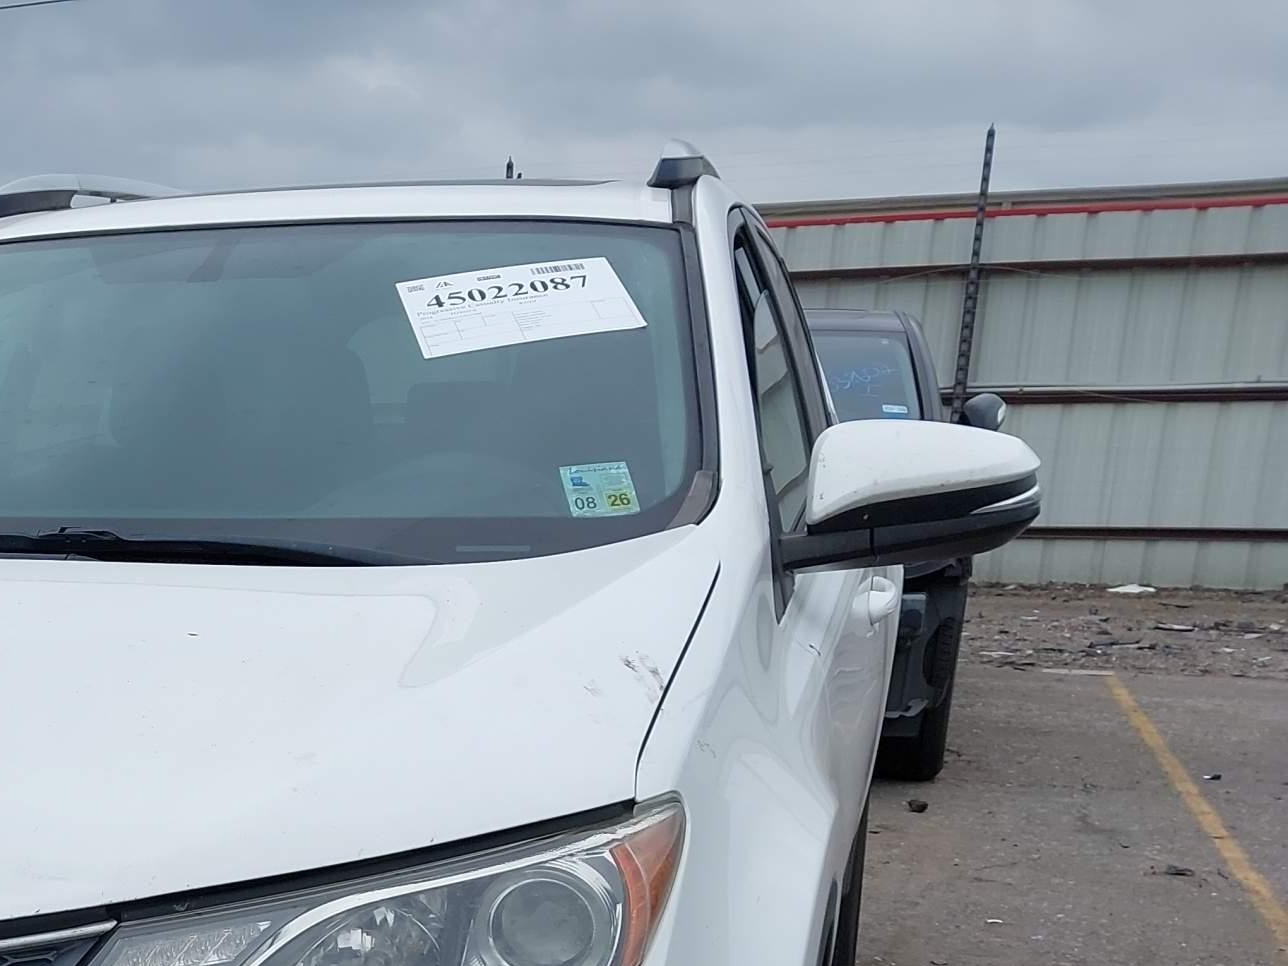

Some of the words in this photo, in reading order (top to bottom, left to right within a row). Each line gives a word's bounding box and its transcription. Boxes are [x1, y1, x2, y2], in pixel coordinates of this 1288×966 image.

[426, 274, 588, 308] 45022087
[574, 496, 597, 511] 08
[607, 493, 631, 507] 26
